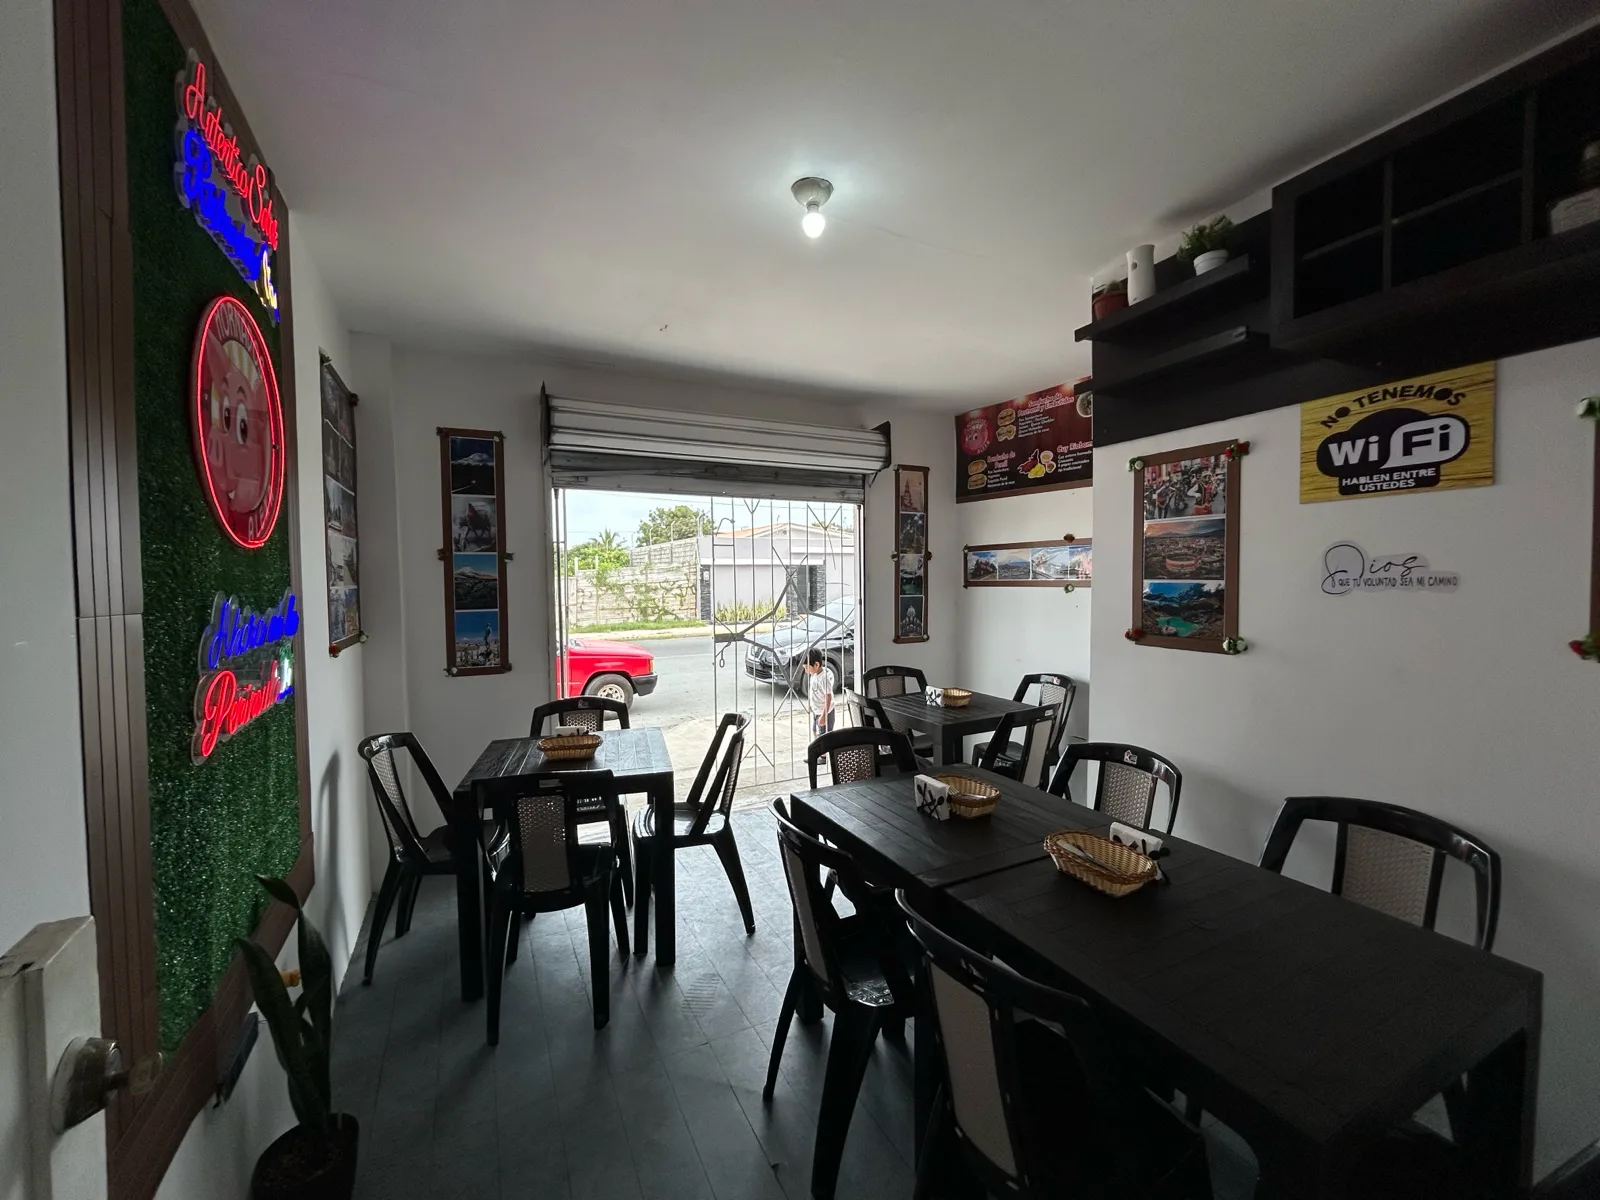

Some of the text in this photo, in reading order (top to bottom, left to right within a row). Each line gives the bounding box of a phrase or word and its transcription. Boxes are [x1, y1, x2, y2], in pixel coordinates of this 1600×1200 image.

[1320, 385, 1467, 430] NO TENEMOS
[1342, 467, 1436, 487] HABLEN ENTRE
[1360, 479, 1416, 493] USTEDES
[1363, 577, 1397, 588] VOLUNTAD
[1400, 576, 1414, 587] SEA
[1417, 576, 1425, 587] MI
[1427, 576, 1458, 587] CAMINO
